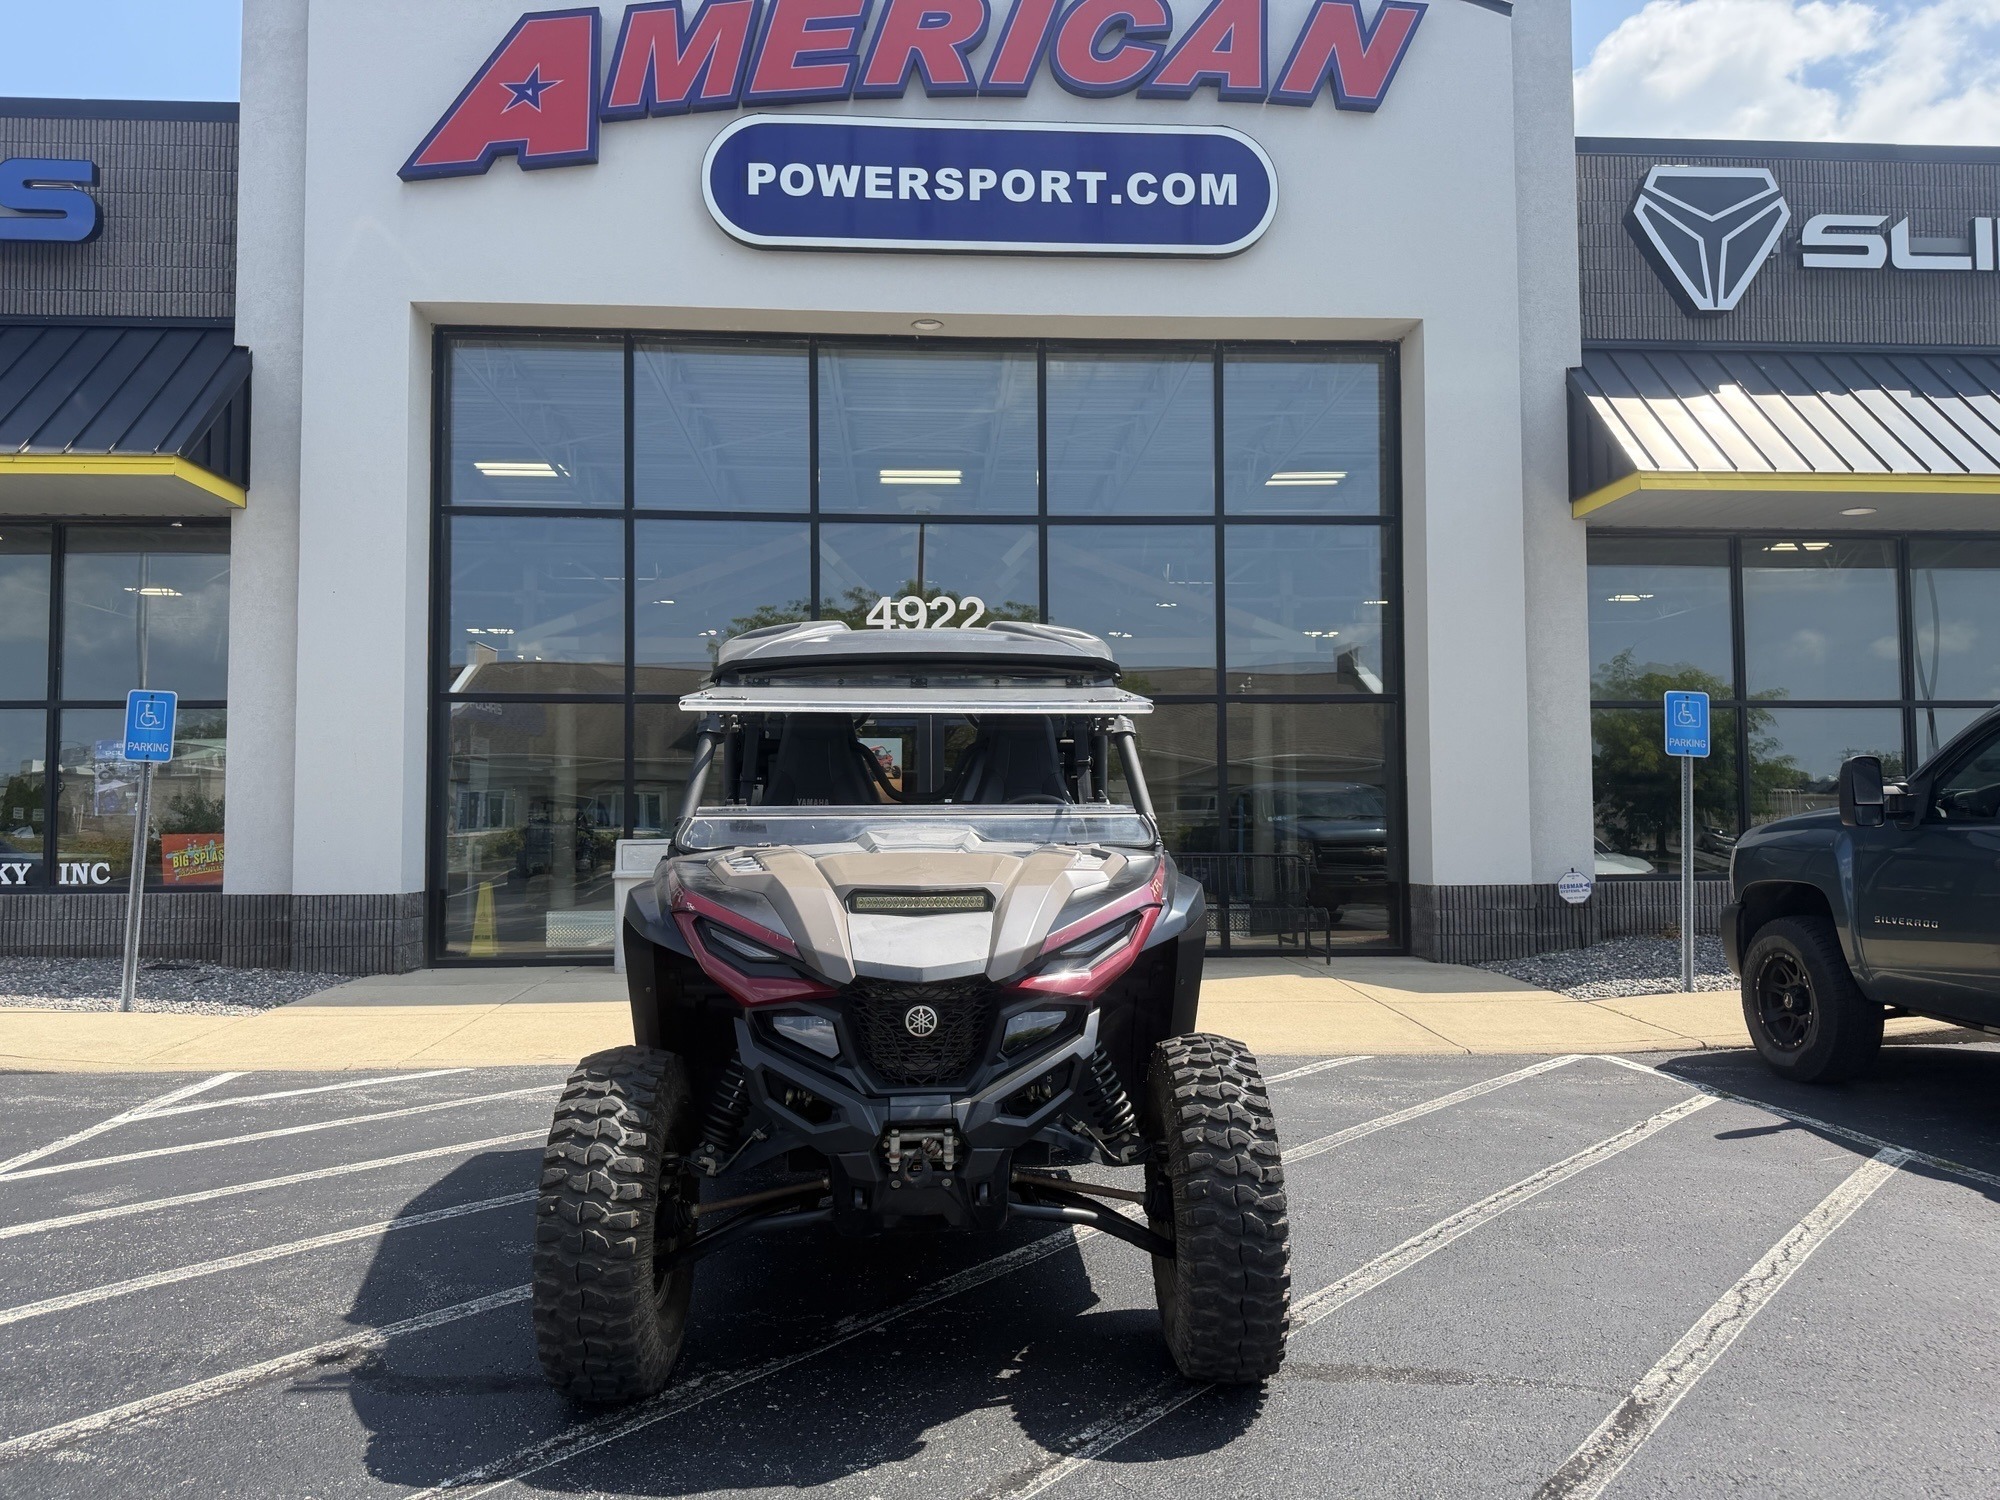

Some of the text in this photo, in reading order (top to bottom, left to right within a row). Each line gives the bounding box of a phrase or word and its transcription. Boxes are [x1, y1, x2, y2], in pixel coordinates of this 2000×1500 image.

[398, 0, 1428, 181] AMERICAN
[747, 162, 1238, 206] POWERSPORT.COM
[1801, 213, 2000, 271] SLI
[866, 595, 985, 630] 4922
[127, 741, 169, 753] PARKING
[1669, 737, 1707, 749] PARKING
[796, 798, 829, 806] YAMAHA
[172, 854, 190, 869] BIG
[59, 862, 111, 885] INC
[1874, 915, 1939, 929] SILVERADO
